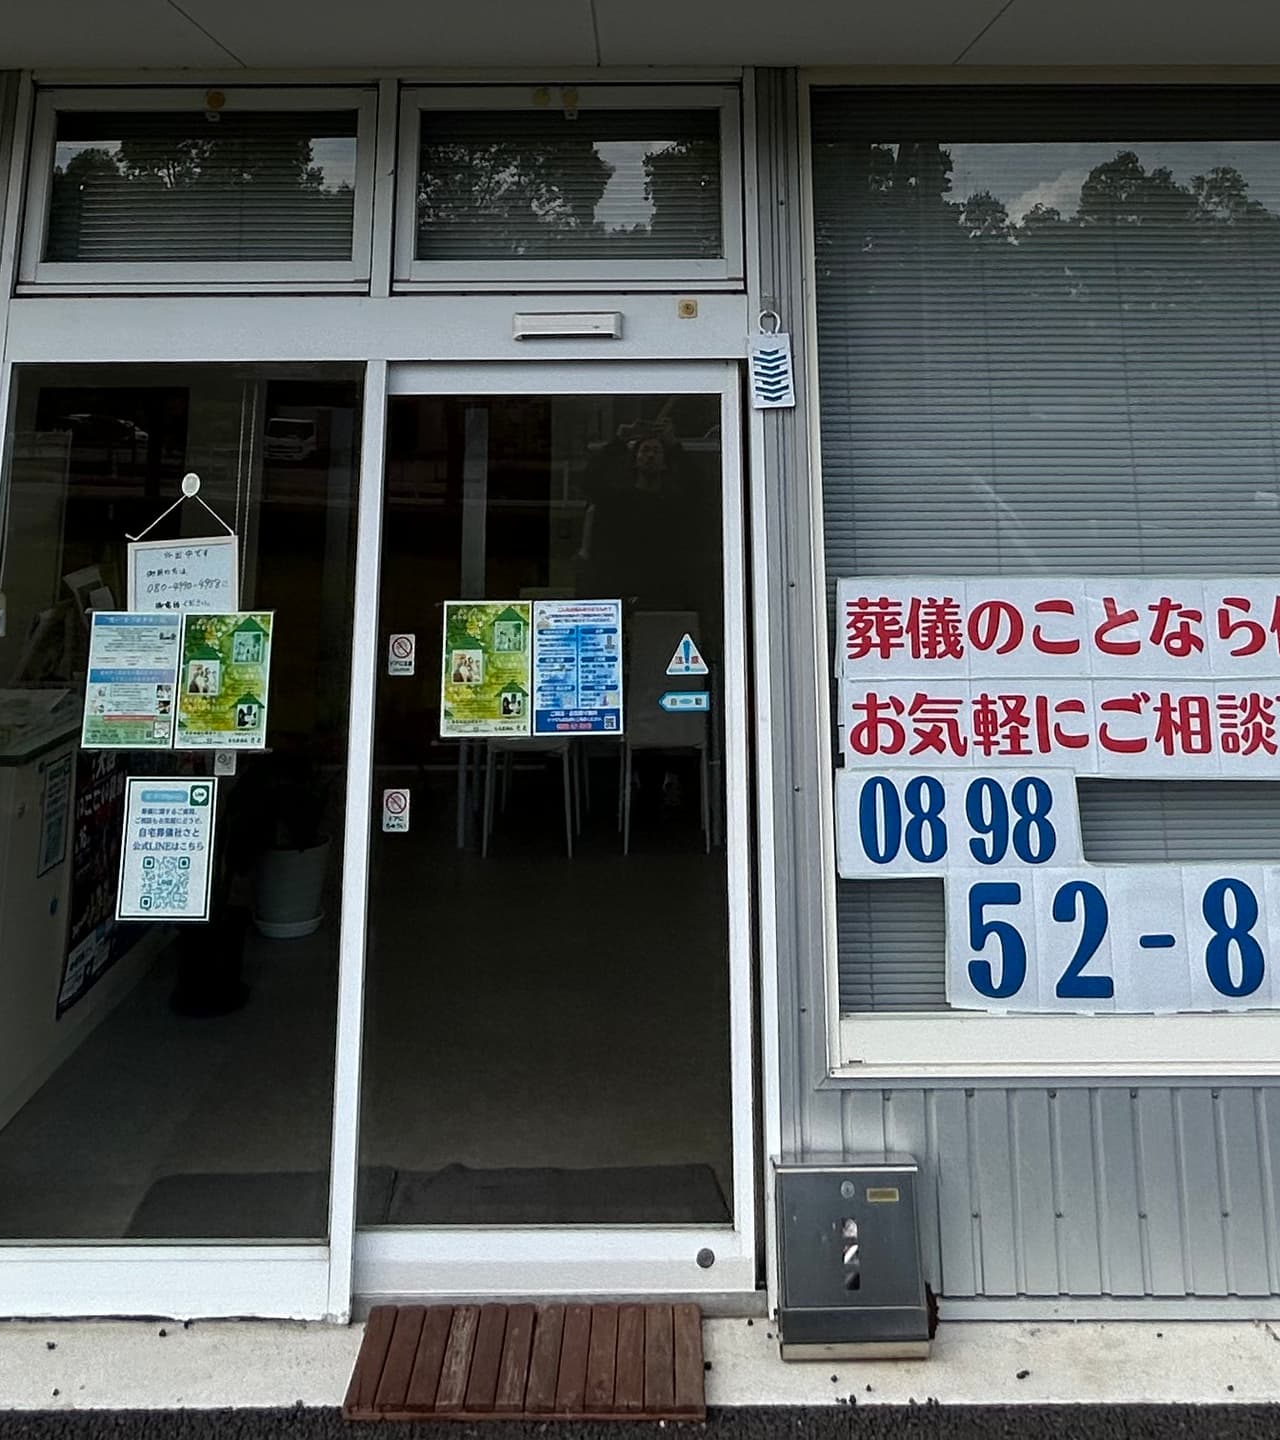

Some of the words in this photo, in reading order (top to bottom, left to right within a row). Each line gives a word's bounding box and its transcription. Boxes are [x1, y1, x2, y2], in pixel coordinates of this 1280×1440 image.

[858, 775, 1057, 865] 0898
[138, 828, 200, 838] 自宅葬儀社さと
[132, 841, 204, 851] 公式LINEはこちら
